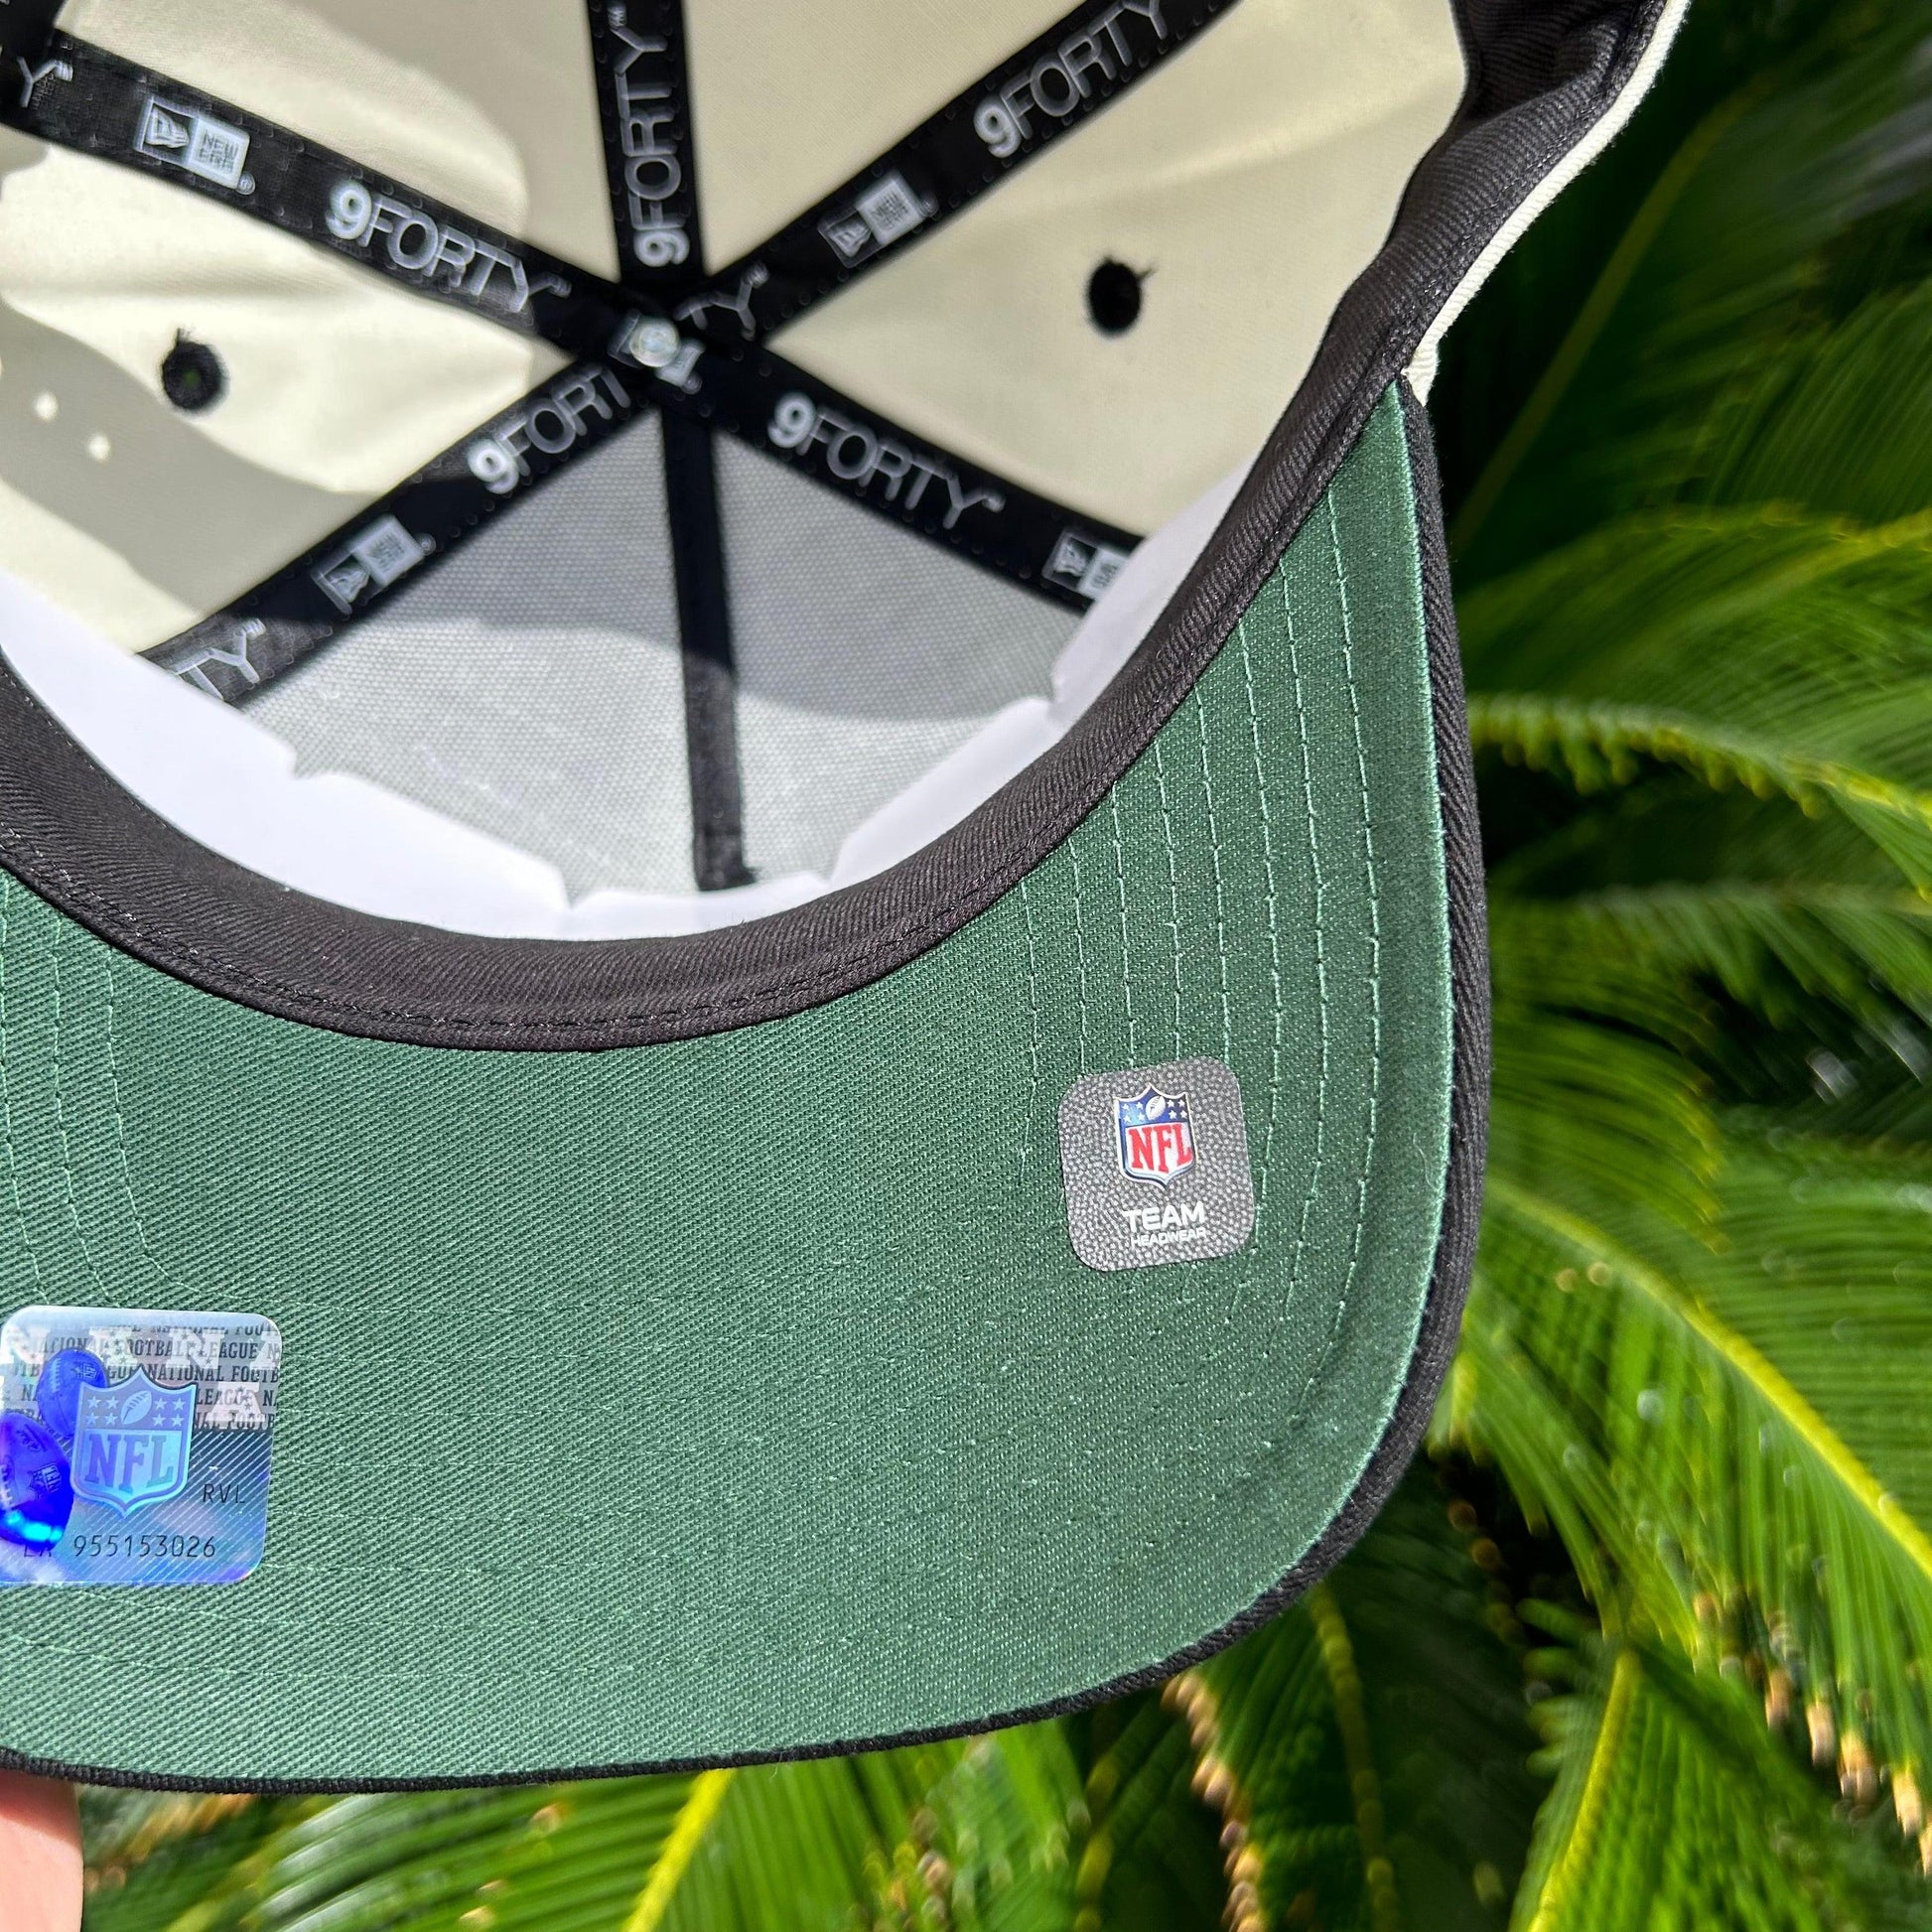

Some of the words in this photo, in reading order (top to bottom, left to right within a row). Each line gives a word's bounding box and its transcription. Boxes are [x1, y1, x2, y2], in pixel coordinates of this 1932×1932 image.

[974, 0, 1168, 157] 9FORTY
[609, 26, 690, 268] 9FORTY
[326, 179, 559, 312] 9FORTY
[468, 363, 631, 494] 9FORT
[767, 392, 990, 530] 9FORTY
[1128, 1123, 1193, 1174] NFL
[1122, 1200, 1206, 1235] TEAM
[85, 1434, 175, 1494] NFL
[72, 1535, 216, 1558] 955153026
